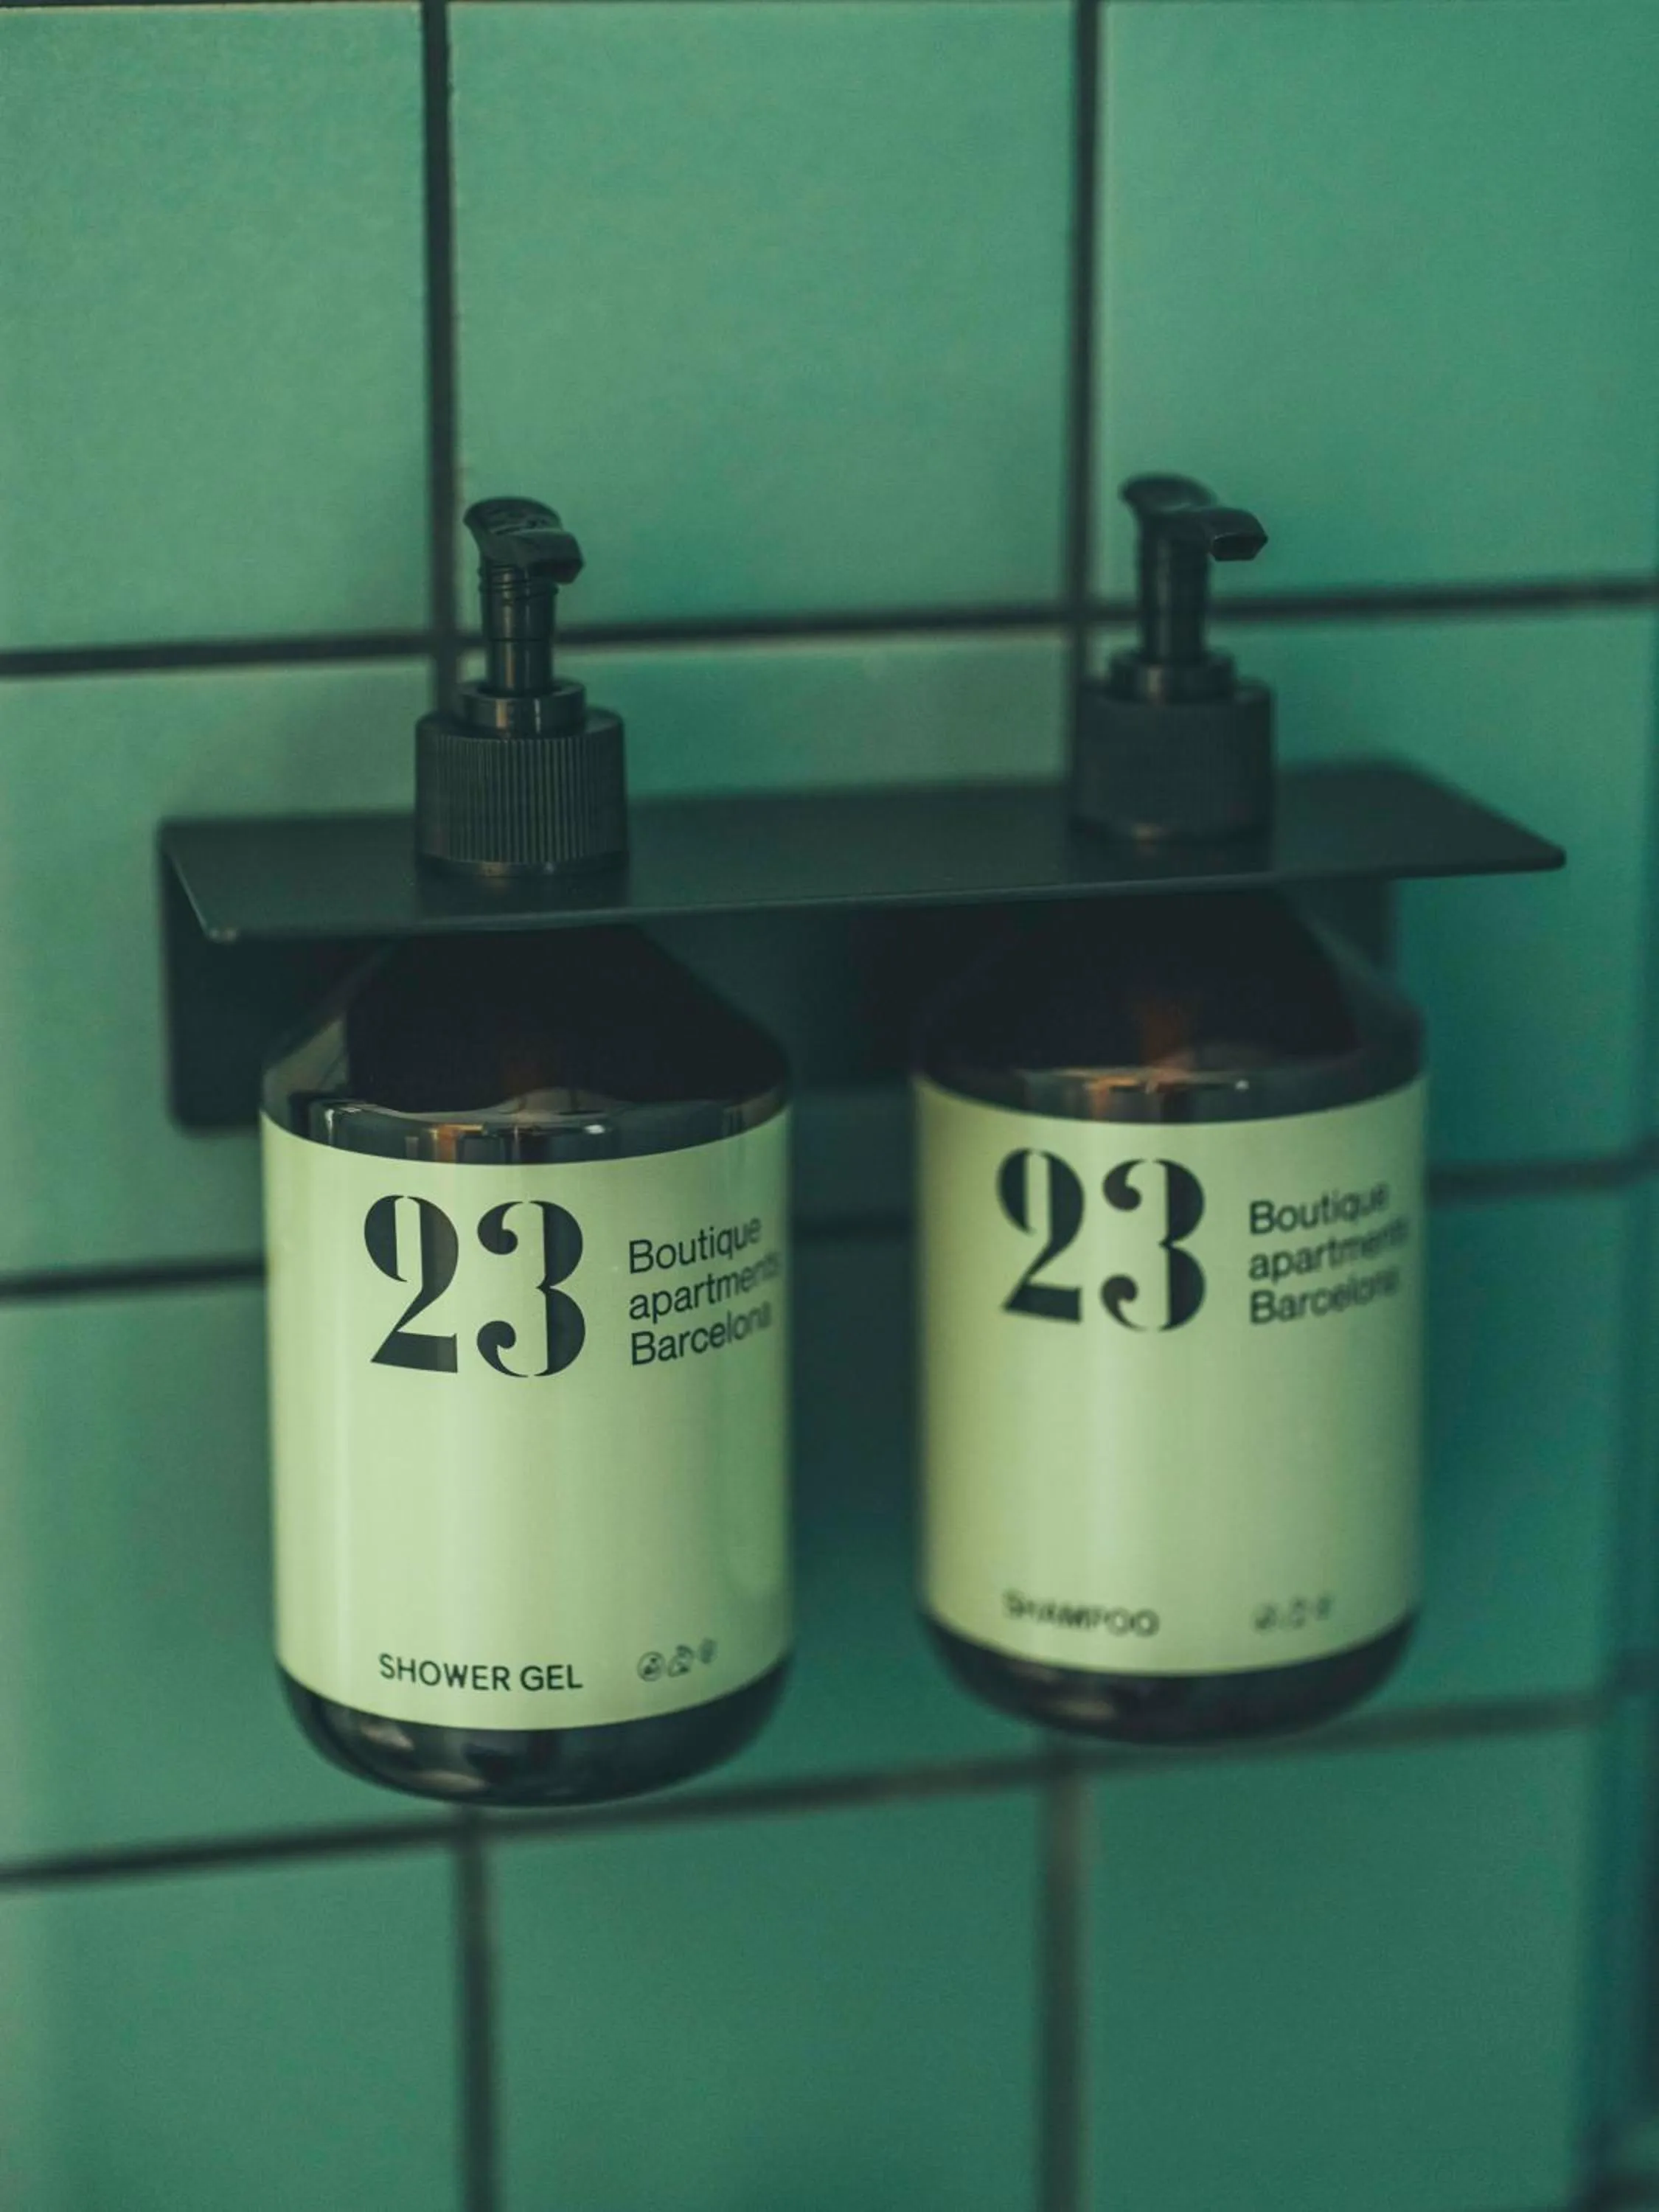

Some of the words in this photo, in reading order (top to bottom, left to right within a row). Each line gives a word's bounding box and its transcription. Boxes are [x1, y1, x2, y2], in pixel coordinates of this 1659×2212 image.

[364, 1194, 585, 1377] 23
[628, 1217, 762, 1275] Boutique
[996, 1147, 1206, 1332] 23
[378, 1652, 512, 1692] SHOWER
[520, 1664, 583, 1691] GEL
